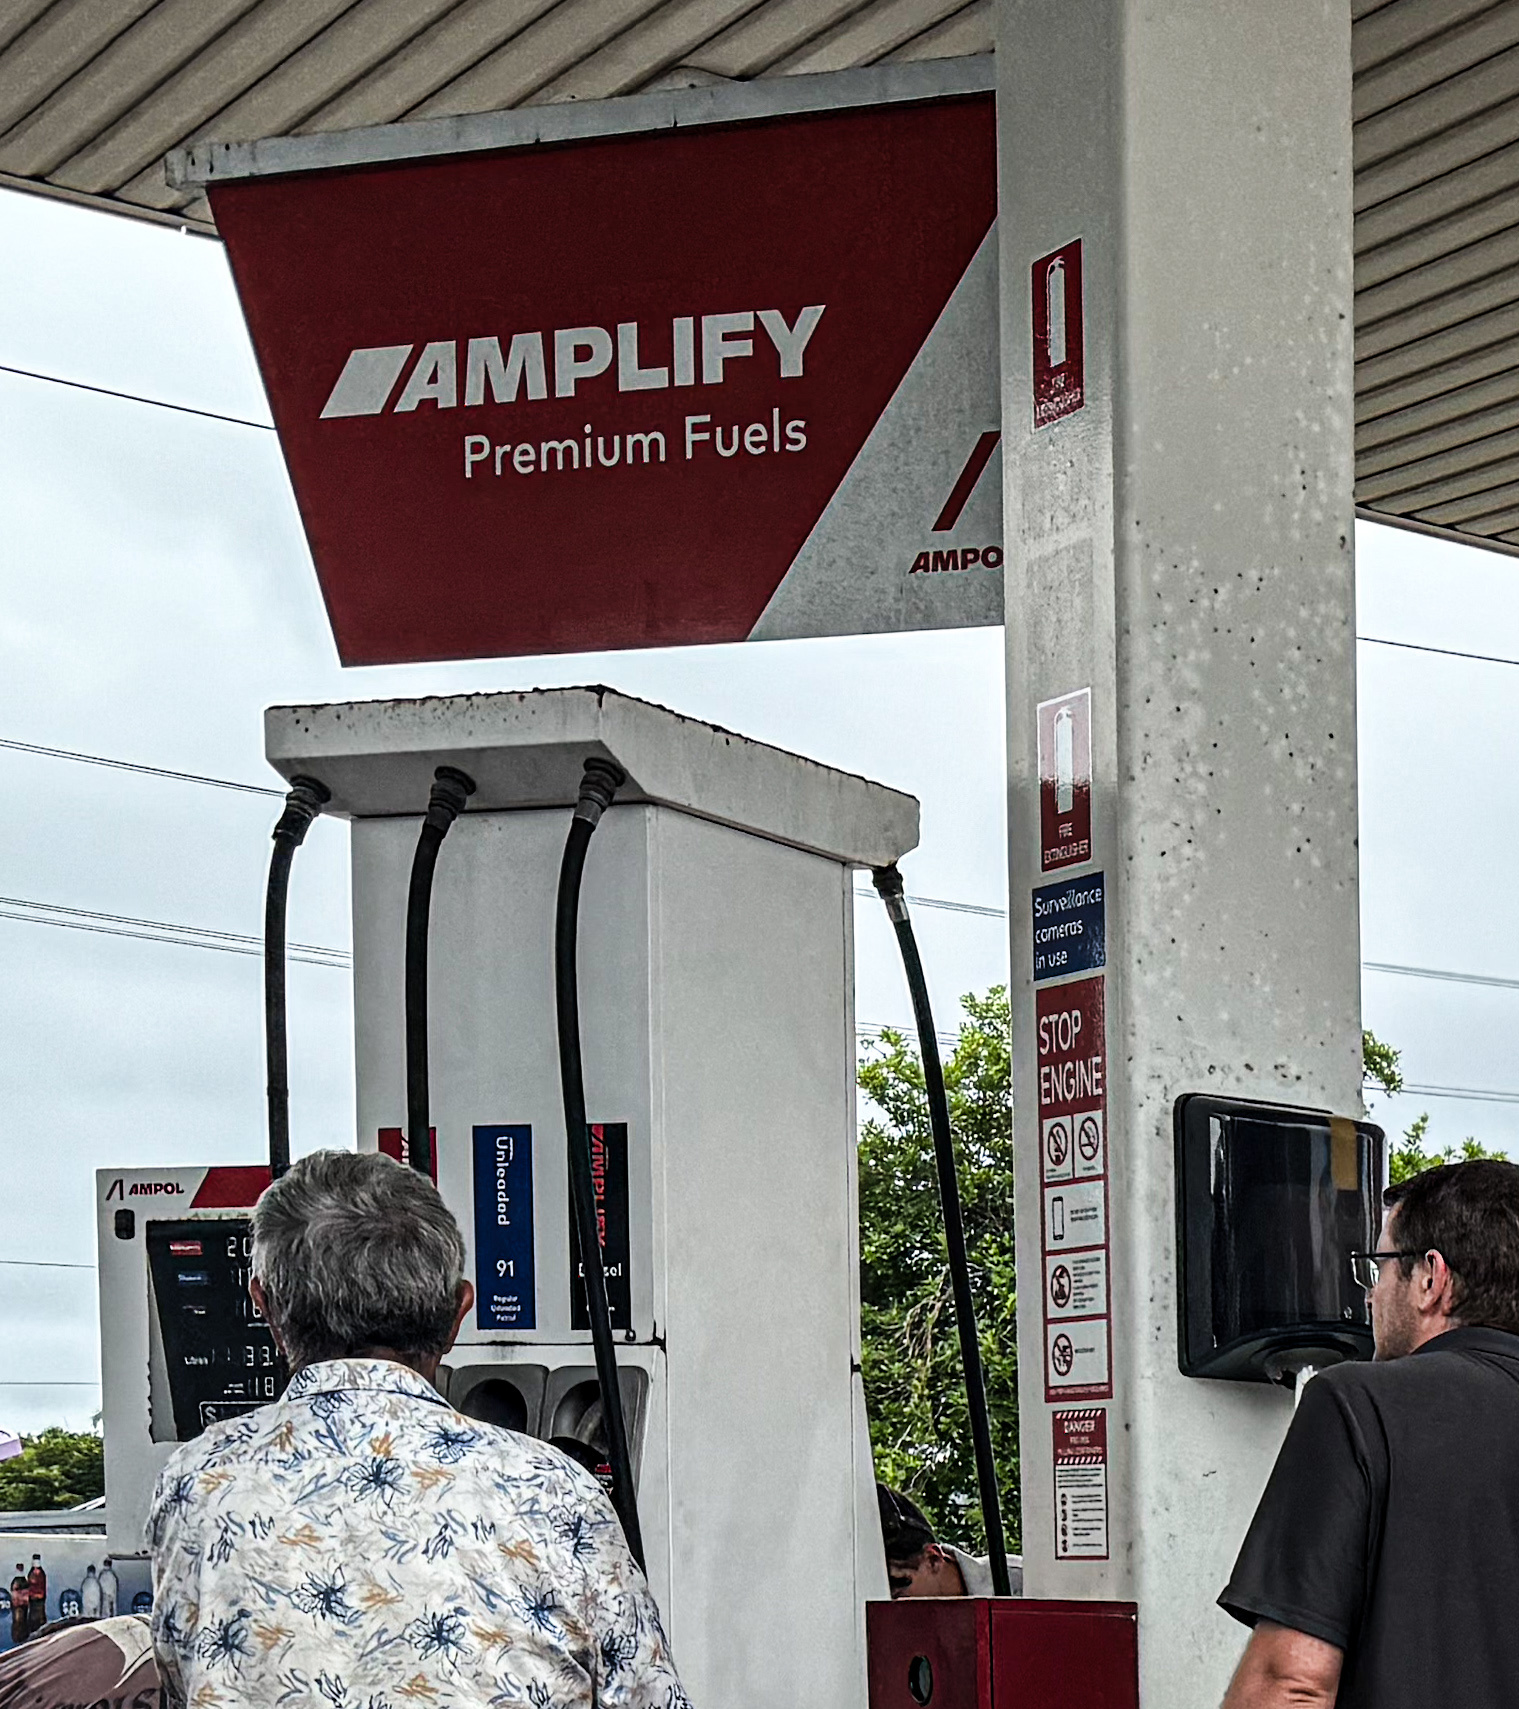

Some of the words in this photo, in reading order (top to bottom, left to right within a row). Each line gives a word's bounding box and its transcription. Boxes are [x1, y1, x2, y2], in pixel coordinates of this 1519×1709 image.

[393, 304, 826, 414] AMPLIFY
[463, 423, 667, 479] Premium
[685, 407, 808, 461] Fuels
[908, 545, 1004, 574] AMPO
[1034, 887, 1102, 918] Surveillance
[1035, 919, 1083, 944] cameras
[1035, 951, 1046, 970] in
[1047, 950, 1068, 967] use
[1040, 1009, 1082, 1055] STOP
[1041, 1056, 1103, 1105] ENGINE
[129, 1183, 185, 1195] AMPOL
[496, 1136, 513, 1226] Unleaded
[496, 1259, 514, 1278] 91
